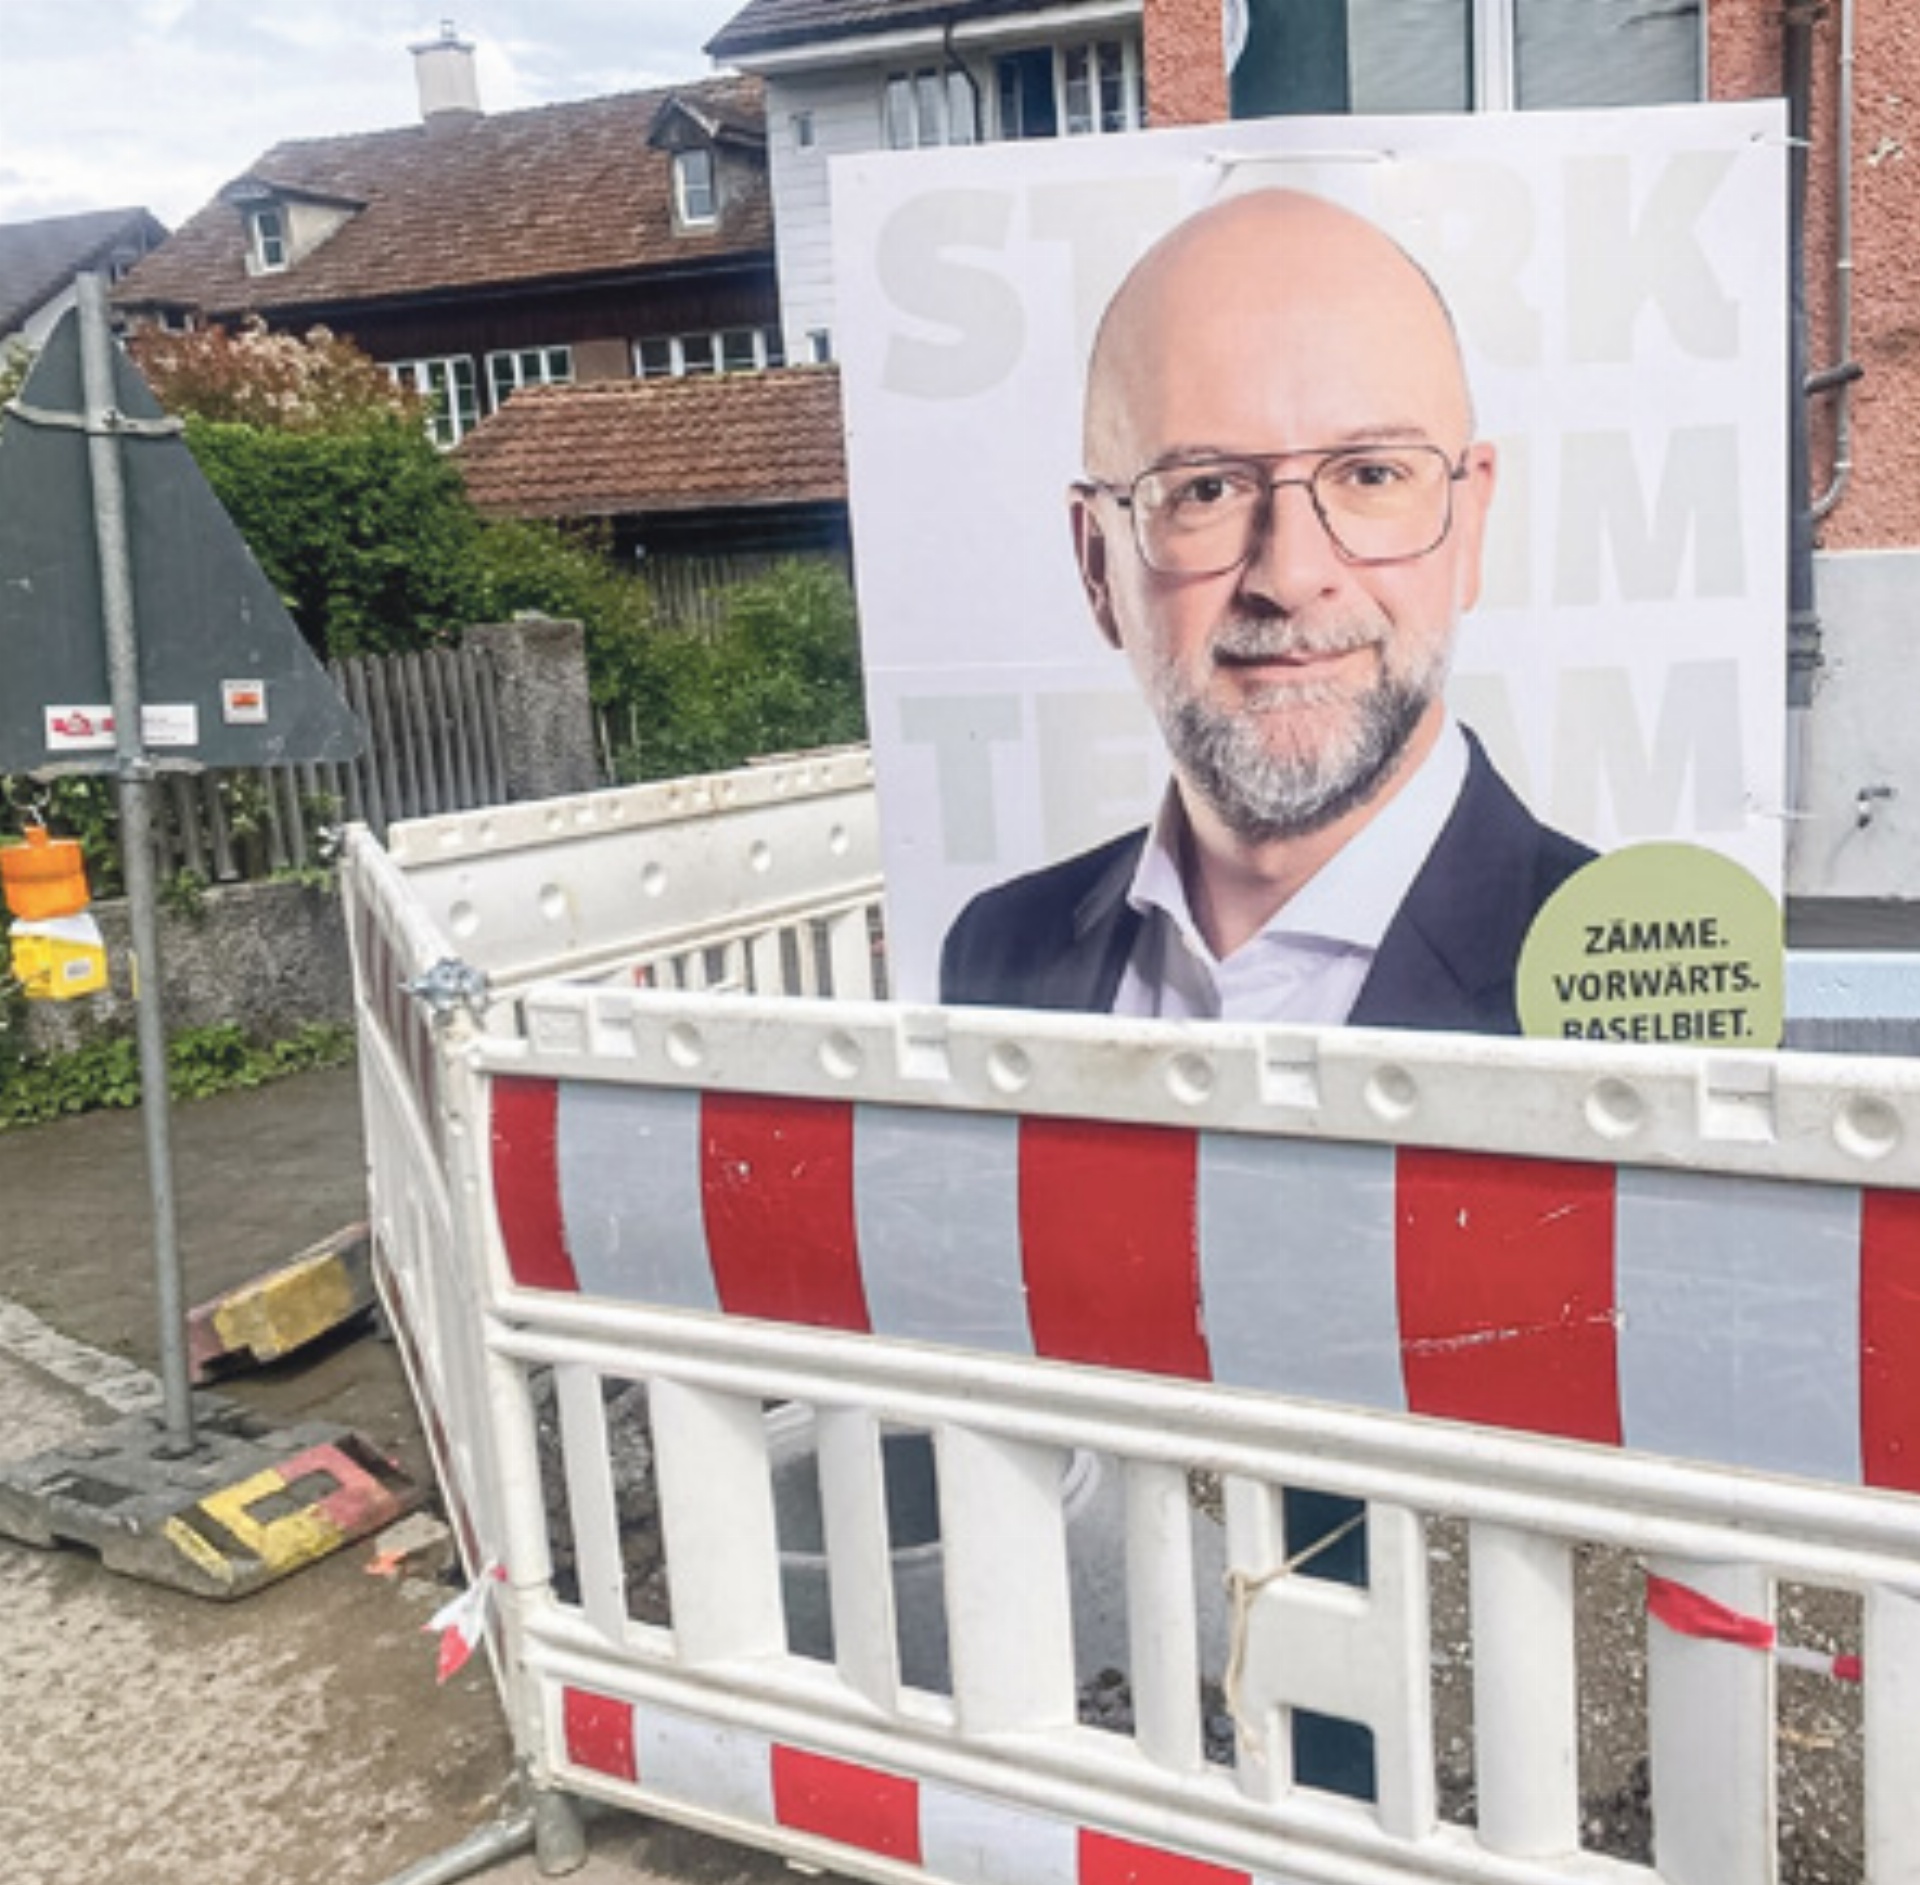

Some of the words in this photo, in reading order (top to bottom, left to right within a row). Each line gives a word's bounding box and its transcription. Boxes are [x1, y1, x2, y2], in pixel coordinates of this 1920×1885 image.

[875, 150, 1740, 400] STRK
[1584, 917, 1730, 954] ZÄMME.
[1553, 961, 1760, 1002] VORWÄRTS.
[1563, 1008, 1754, 1043] BASELBIET.
